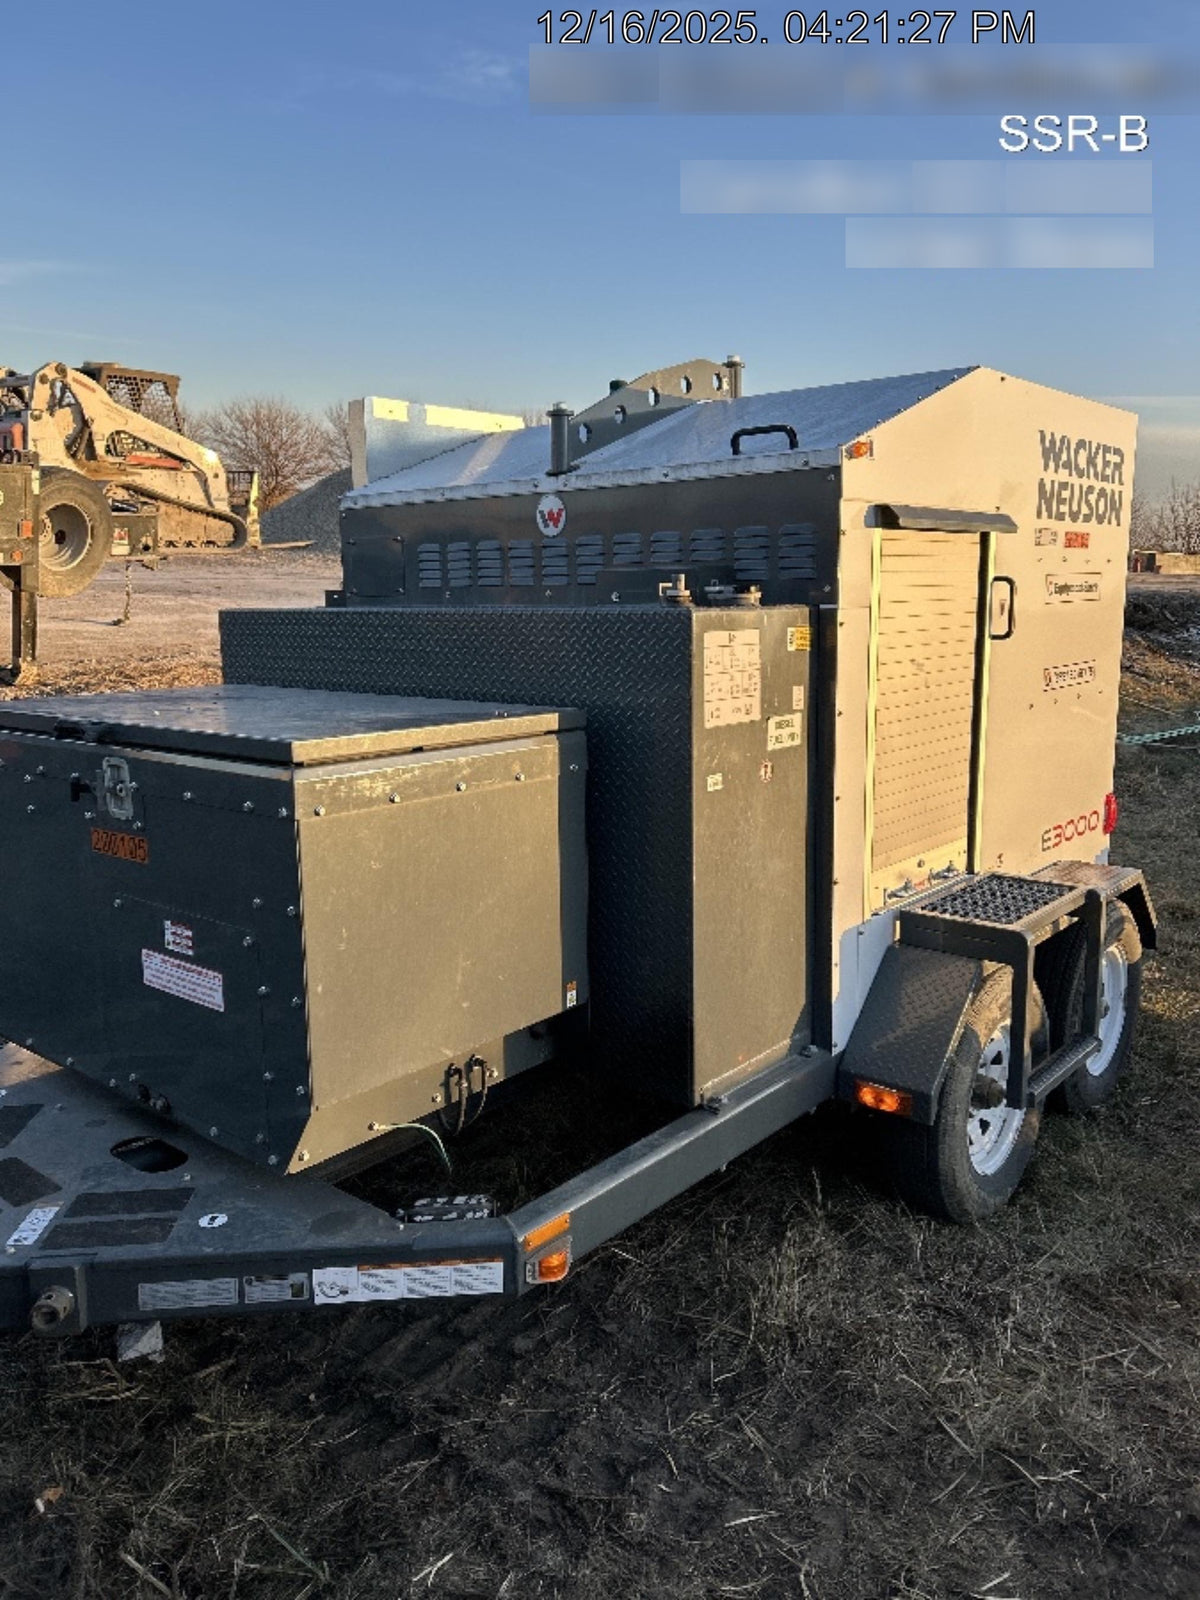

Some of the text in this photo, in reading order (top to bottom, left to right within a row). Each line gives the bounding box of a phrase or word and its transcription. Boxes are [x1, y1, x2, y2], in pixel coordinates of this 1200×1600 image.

[1038, 429, 1125, 486] WACKER
[1036, 477, 1123, 527] NEUSON
[1041, 810, 1100, 852] E3000
